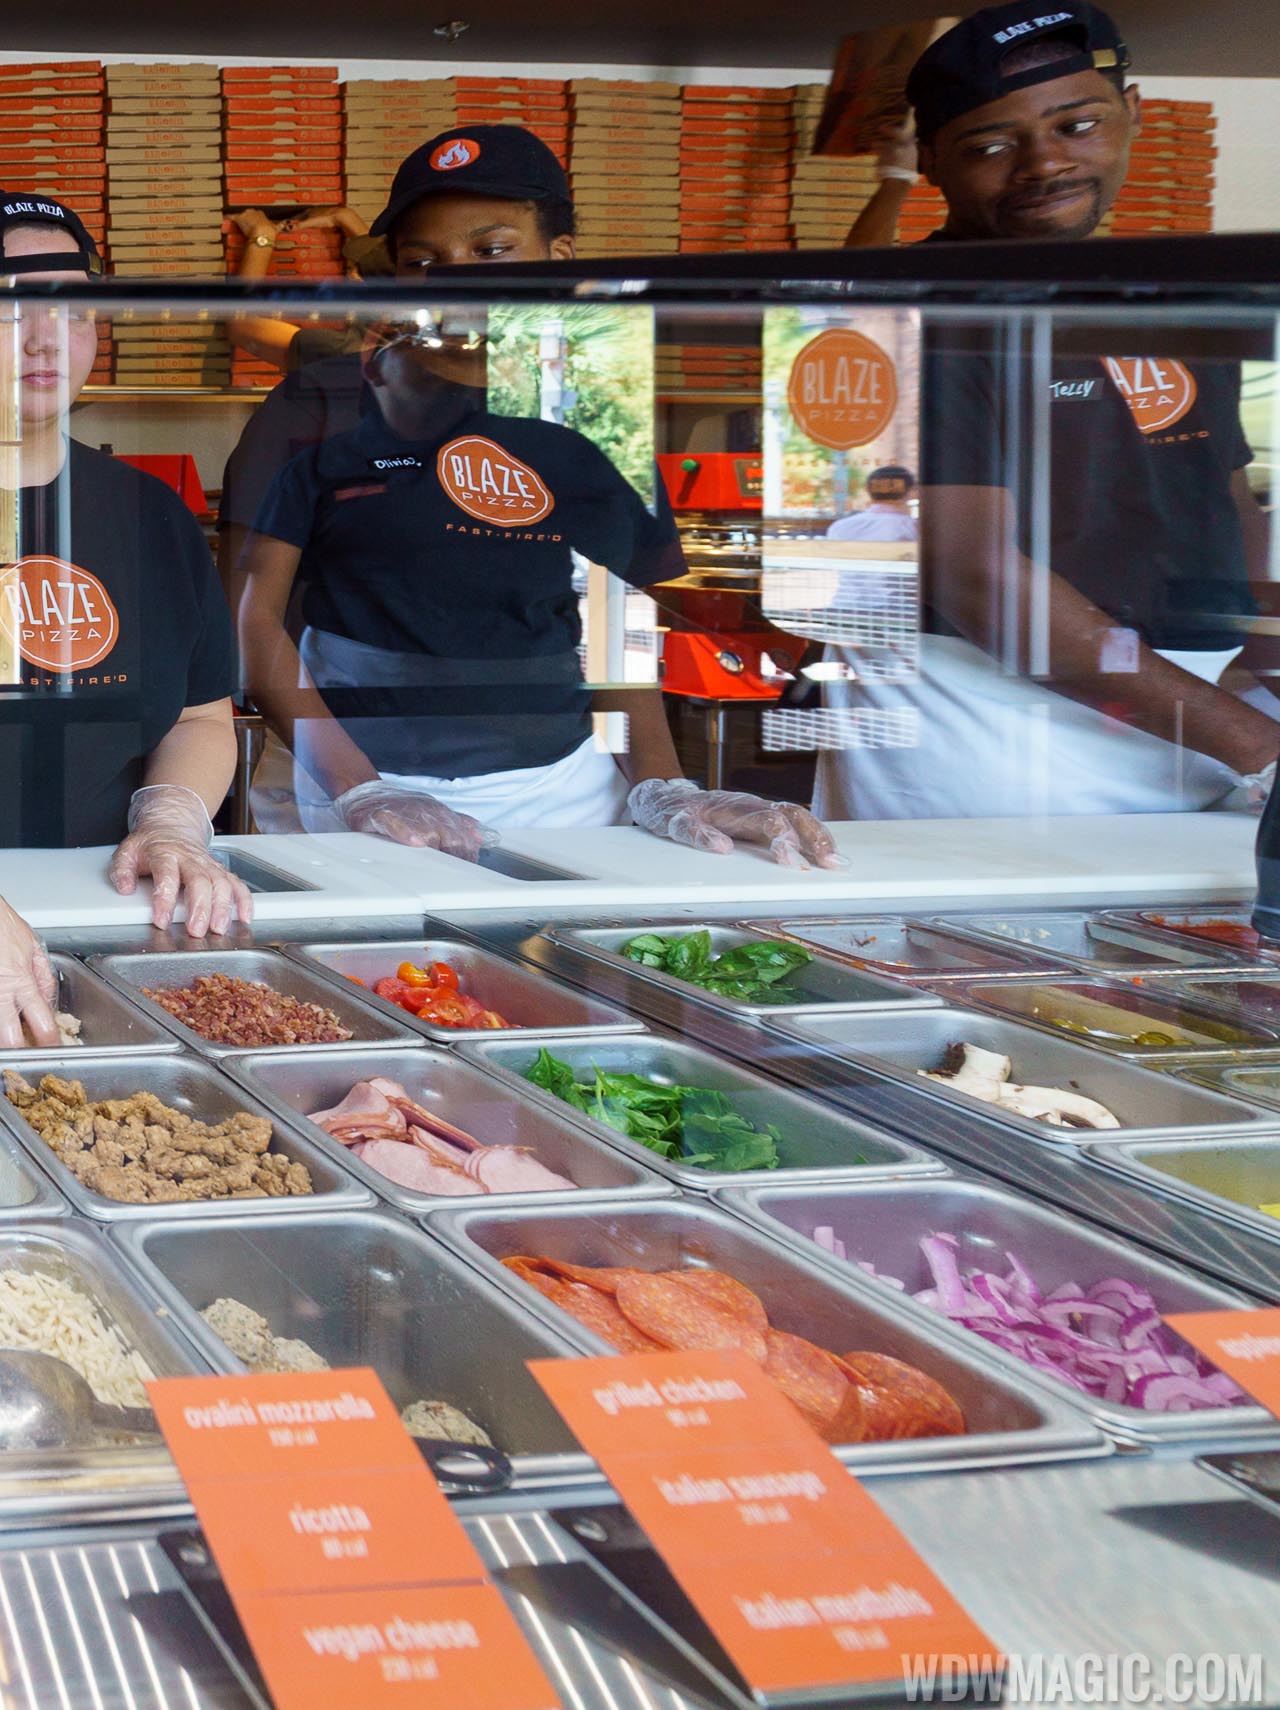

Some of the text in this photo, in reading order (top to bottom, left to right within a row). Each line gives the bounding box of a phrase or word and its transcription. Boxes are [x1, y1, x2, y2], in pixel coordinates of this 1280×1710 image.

[3, 202, 65, 218] BLAZE PIZZA
[803, 356, 883, 404] BLAZE
[1106, 356, 1175, 395] AZE
[809, 409, 878, 422] PIZZA
[450, 455, 536, 499] BLAZE
[461, 491, 536, 508] PIZZA
[4, 579, 101, 625] BLAZE
[22, 628, 102, 642] PIZZA
[183, 1391, 376, 1429] ovalini mozzarella
[288, 1503, 372, 1534] ricotta
[303, 1614, 480, 1662] vegan cheese
